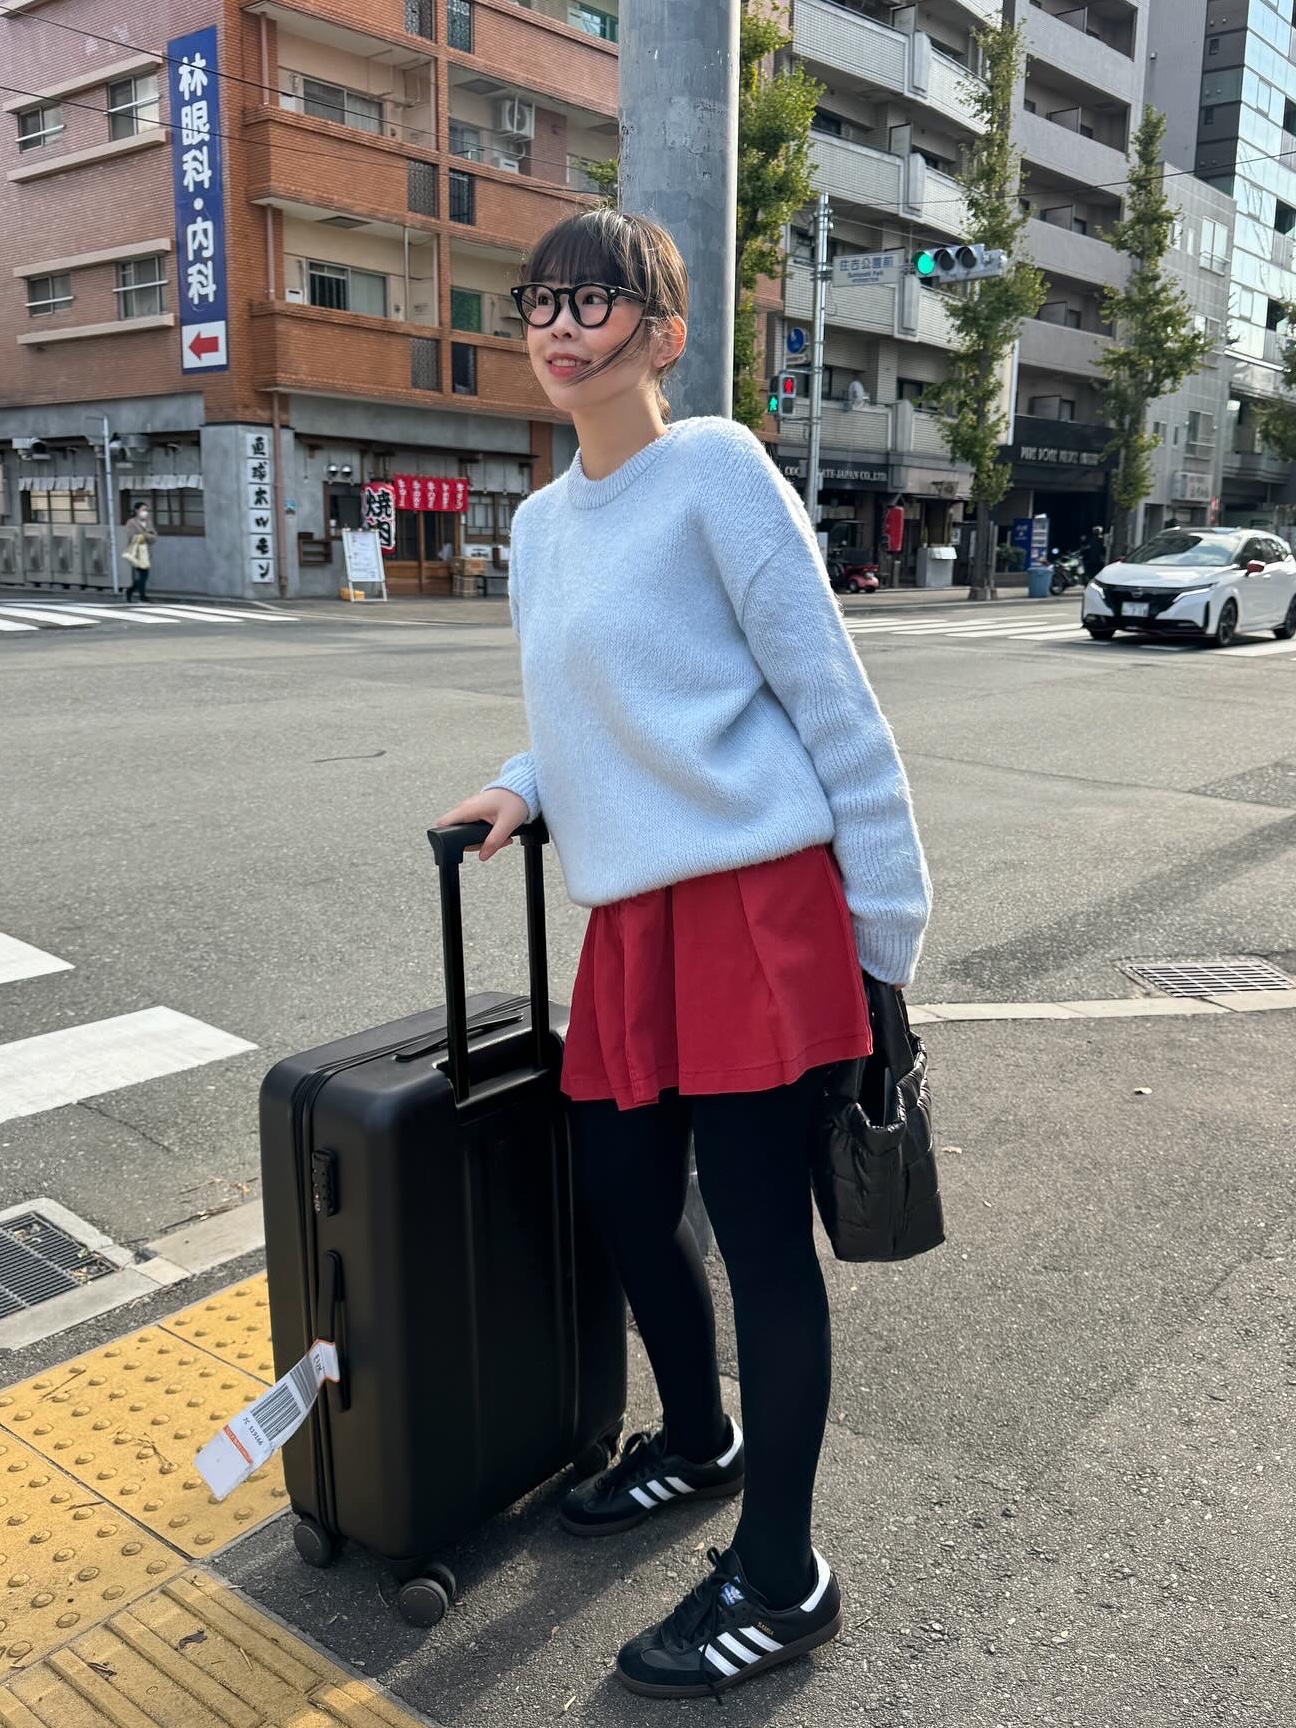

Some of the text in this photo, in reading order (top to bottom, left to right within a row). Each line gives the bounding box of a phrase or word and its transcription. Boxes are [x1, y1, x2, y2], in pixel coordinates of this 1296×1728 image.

[178, 52, 217, 304] 林眼科・内科
[365, 487, 392, 547] 焼肉
